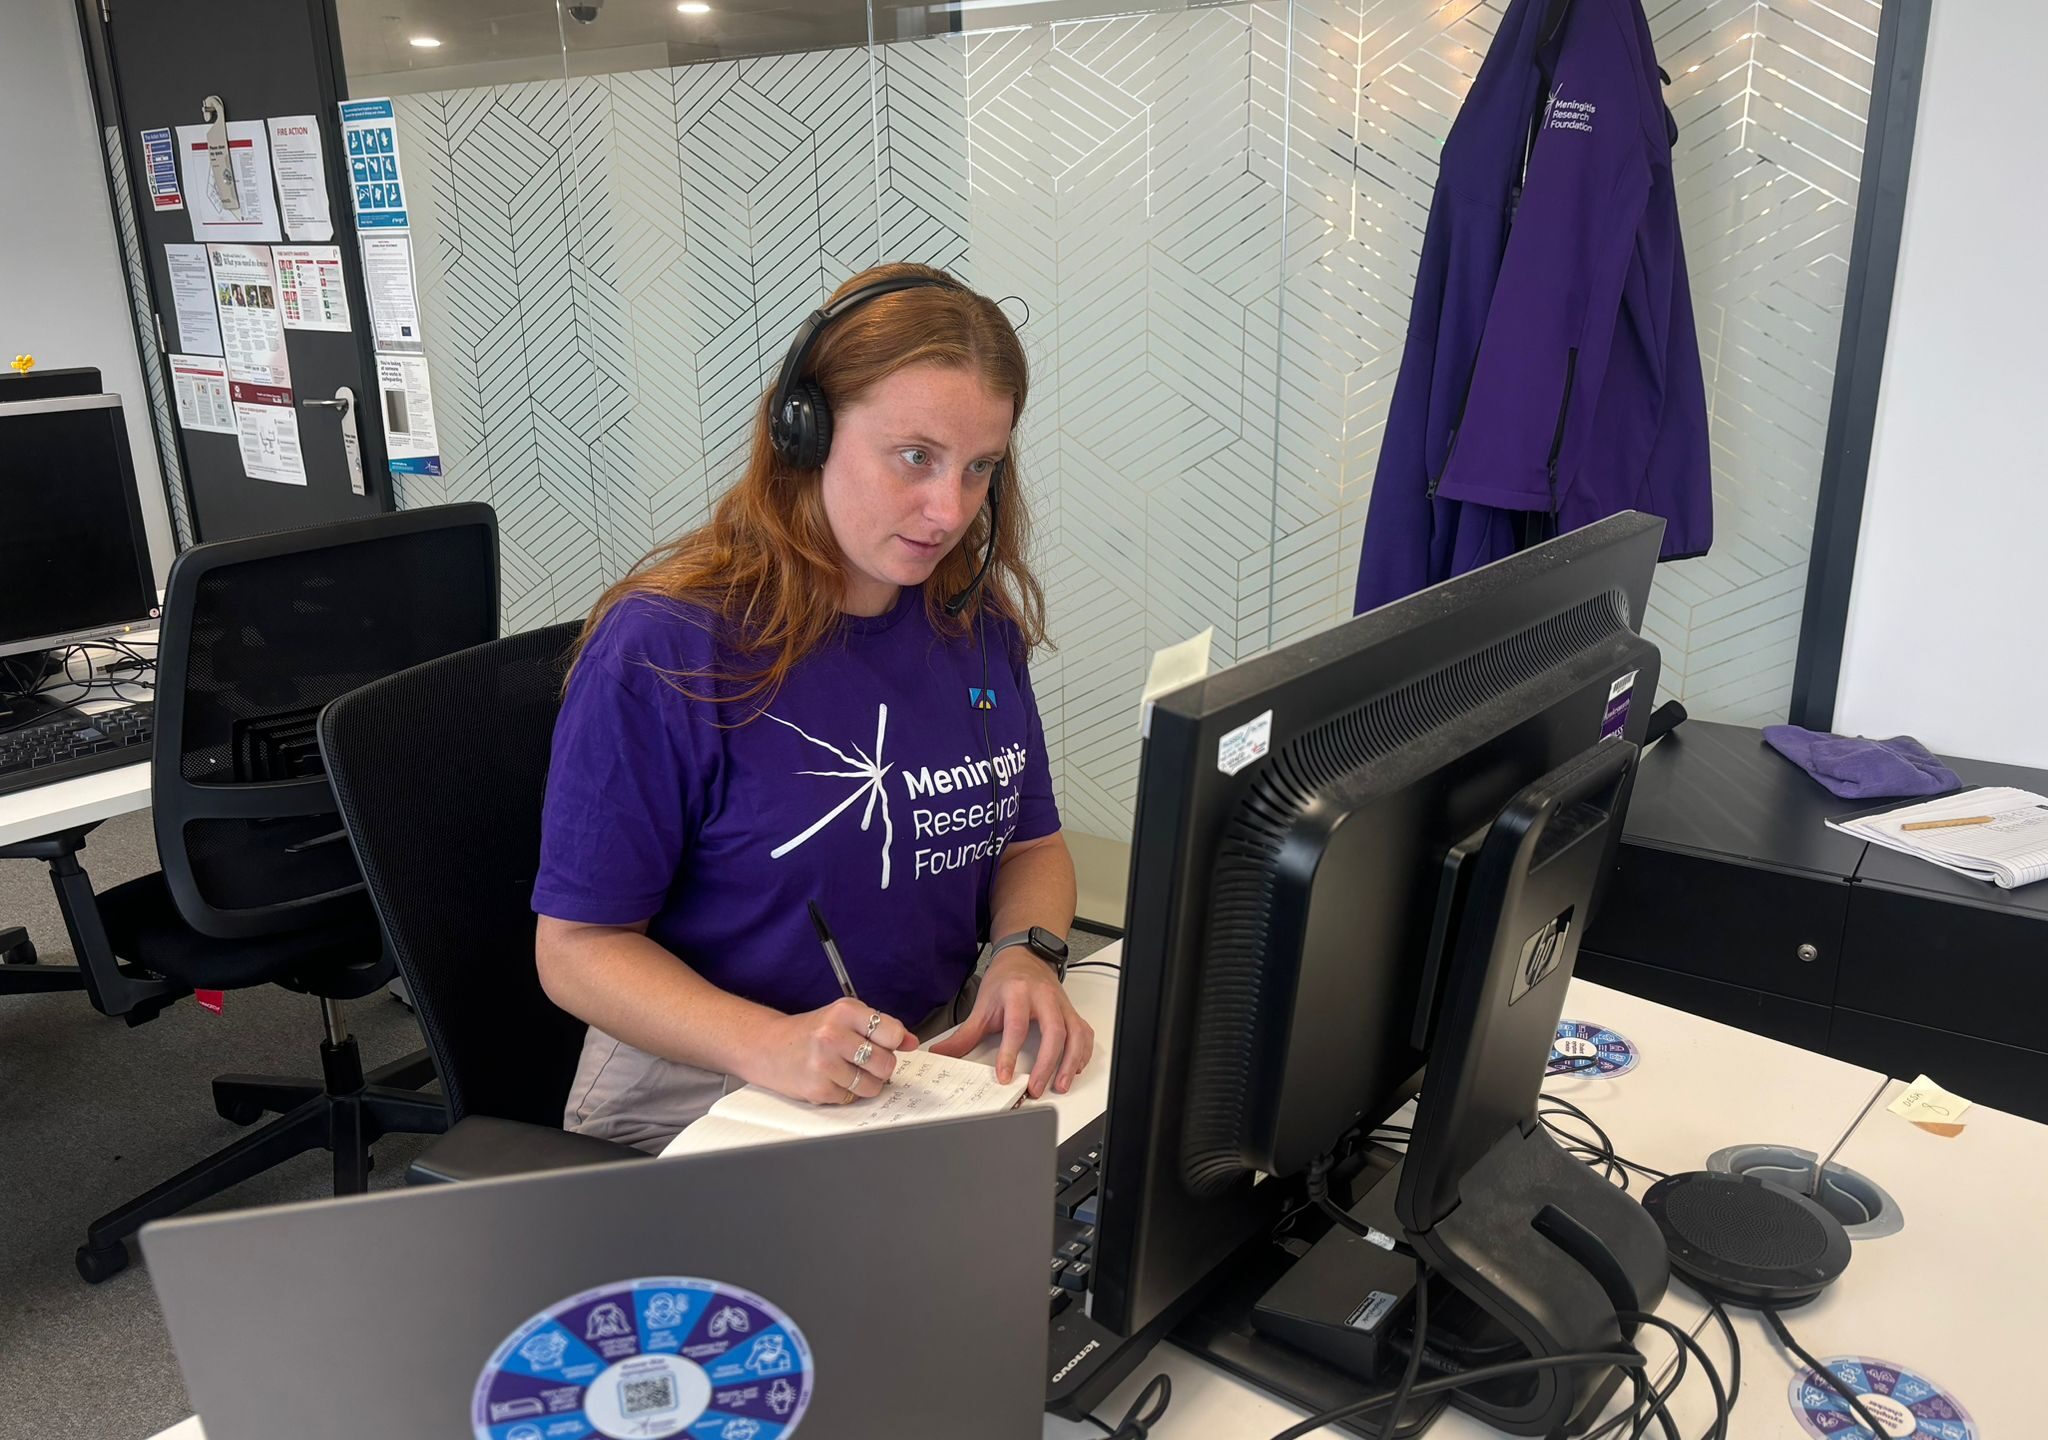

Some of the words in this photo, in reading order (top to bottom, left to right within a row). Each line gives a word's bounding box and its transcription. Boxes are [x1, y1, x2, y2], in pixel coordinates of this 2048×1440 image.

[1555, 100, 1596, 114] Meningitis
[1552, 110, 1590, 122] Research
[276, 127, 288, 136] FIRE
[289, 126, 309, 136] ACTION
[1550, 120, 1593, 132] Foundation
[902, 742, 1027, 801] Meningitis
[913, 785, 1020, 841] Research
[1052, 1339, 1101, 1384] lenovo
